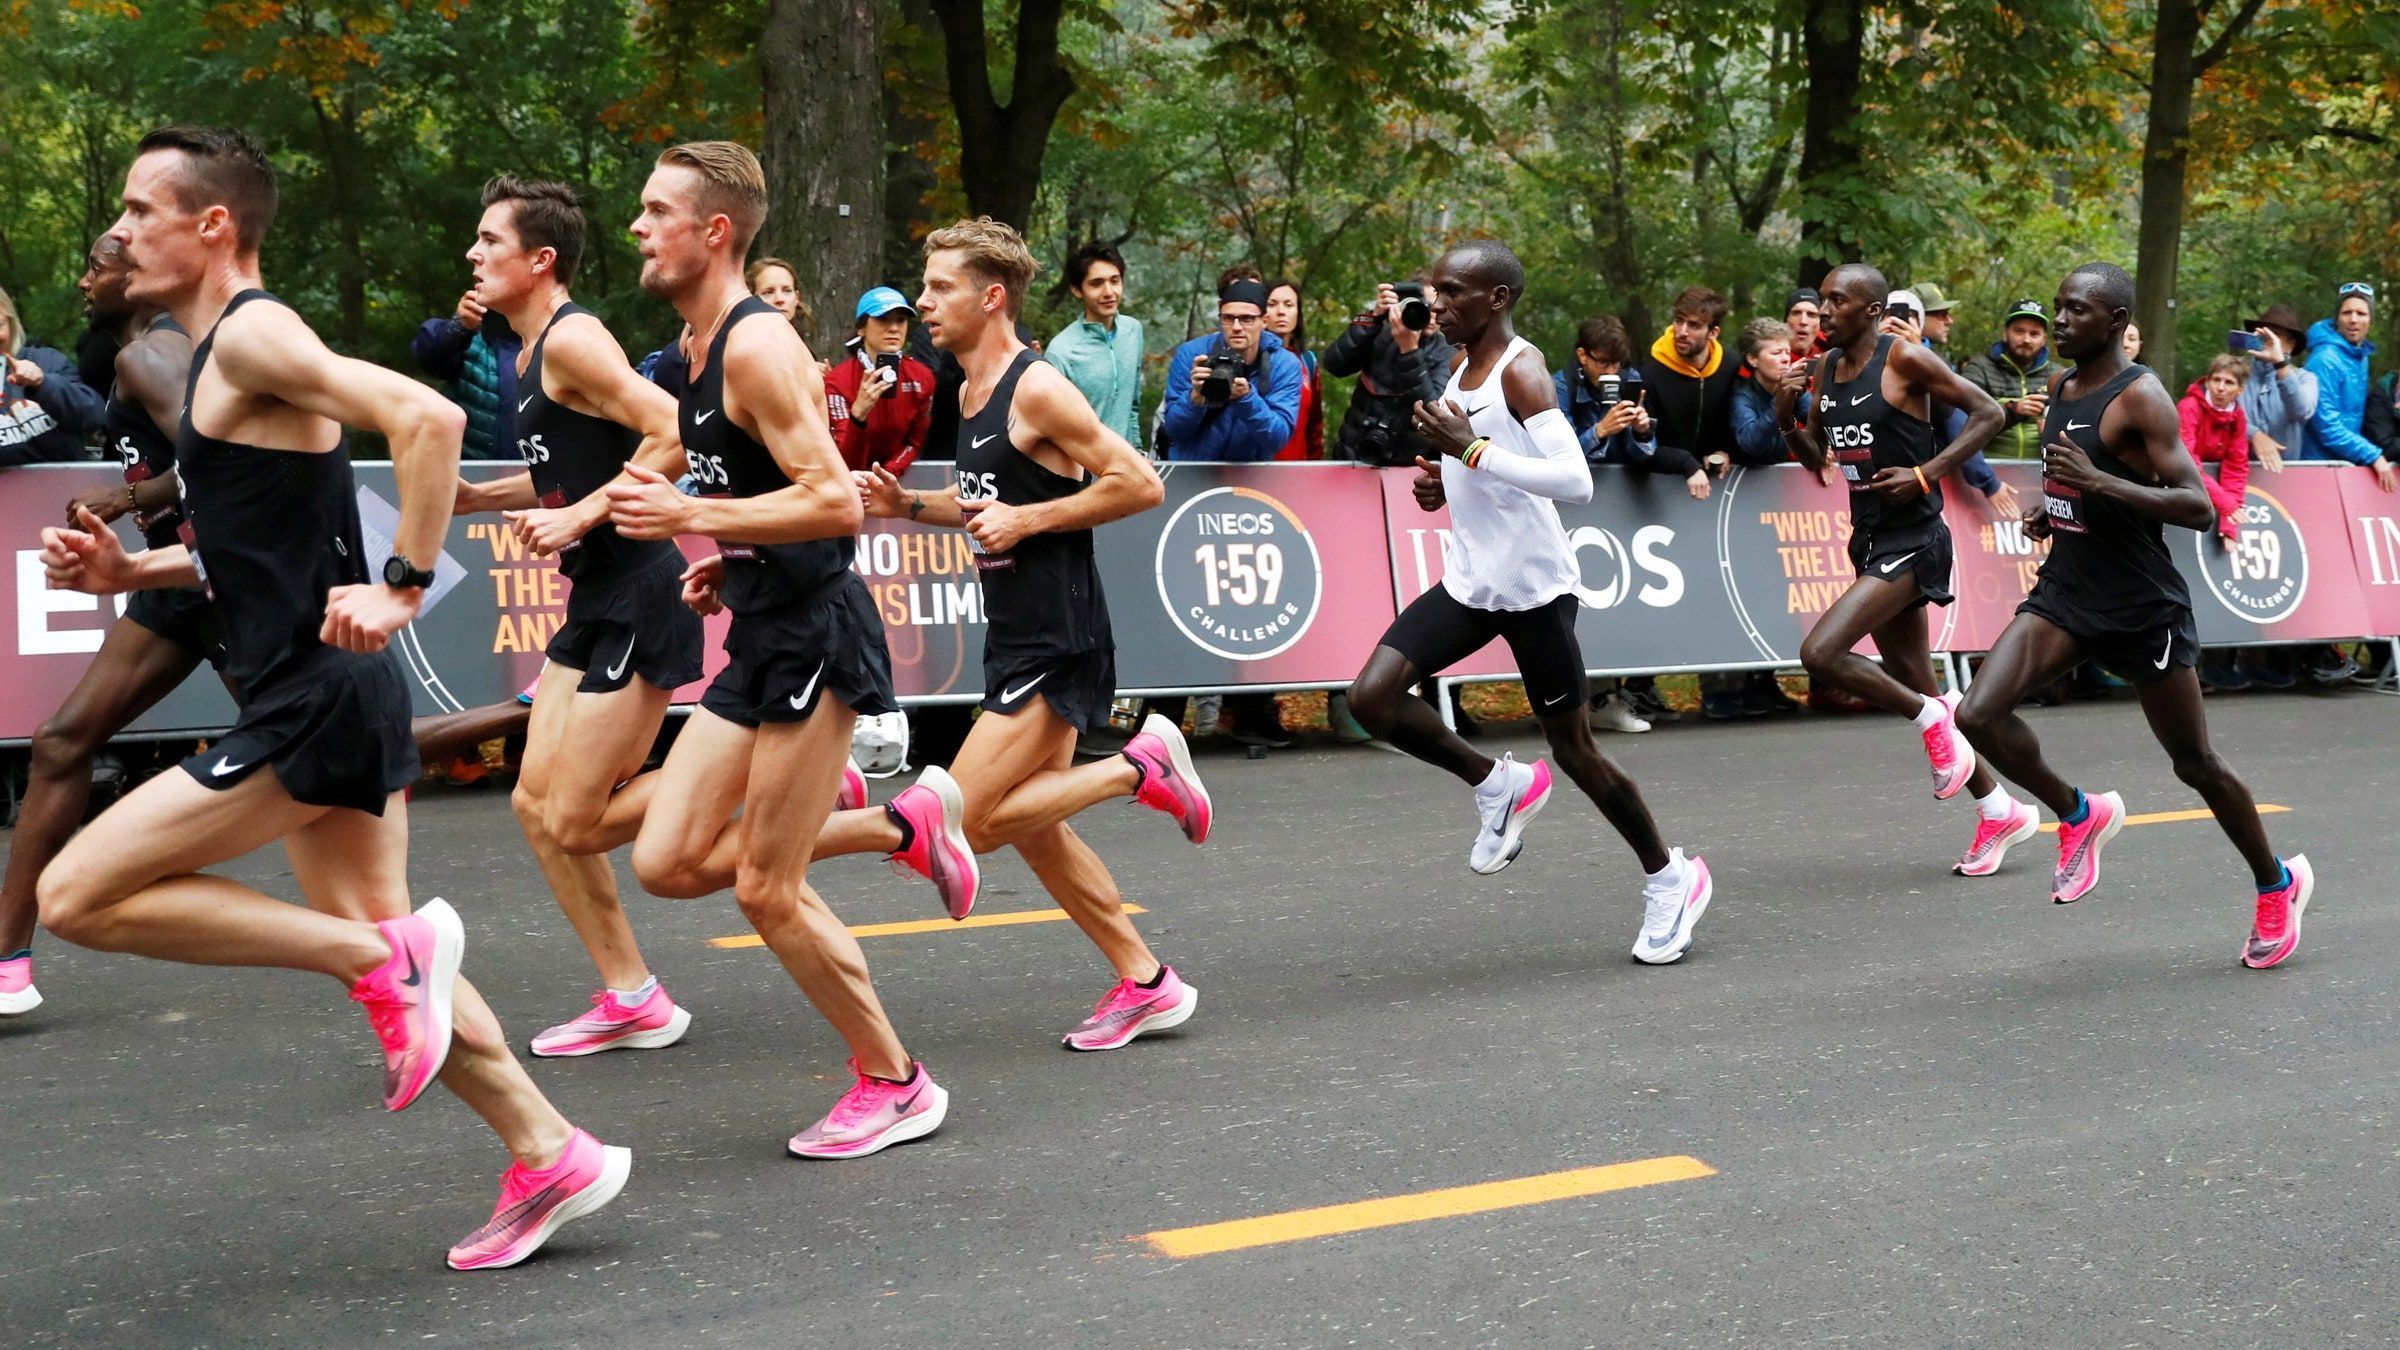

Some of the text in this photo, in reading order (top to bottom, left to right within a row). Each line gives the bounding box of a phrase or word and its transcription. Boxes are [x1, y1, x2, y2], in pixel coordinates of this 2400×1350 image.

[1197, 513, 1275, 535] INEOS
[1195, 543, 1283, 606] 1:59
[1777, 546, 1827, 577] THE
[489, 567, 564, 607] THE
[2223, 576, 2295, 609] CHALLENGE
[1190, 602, 1299, 642] CHALLENGE
